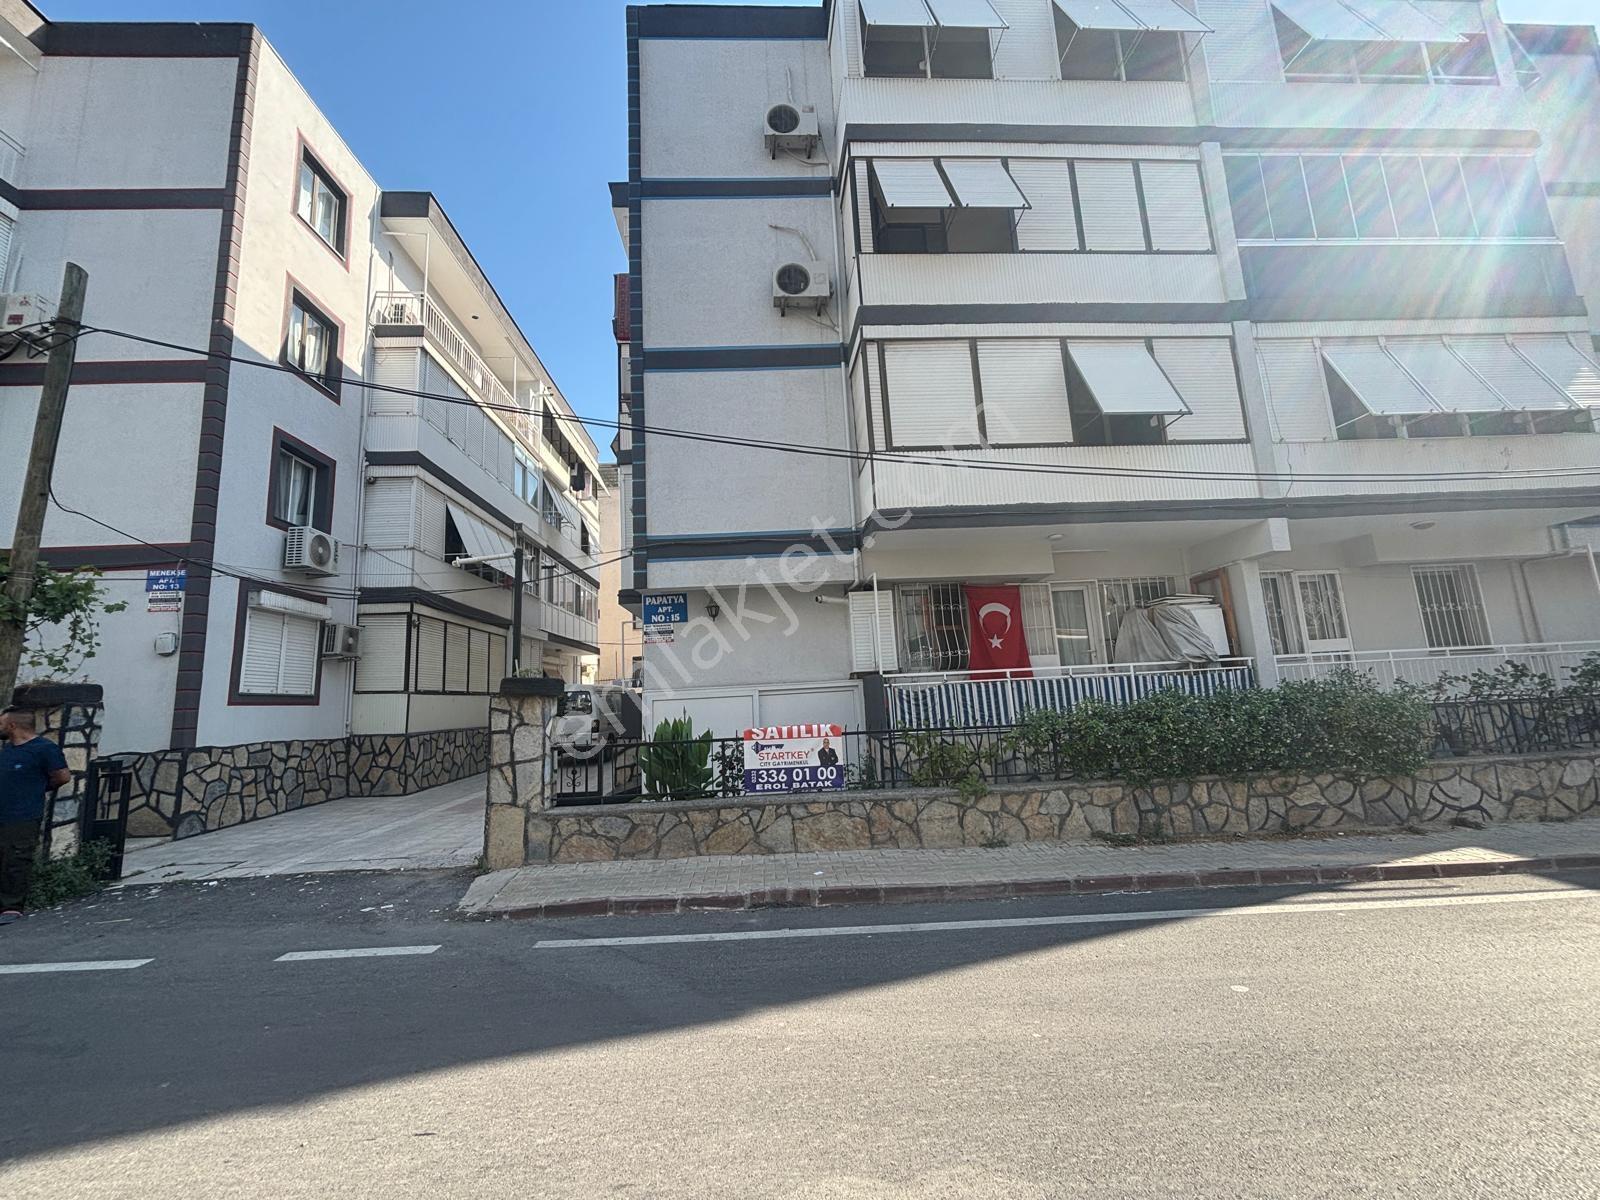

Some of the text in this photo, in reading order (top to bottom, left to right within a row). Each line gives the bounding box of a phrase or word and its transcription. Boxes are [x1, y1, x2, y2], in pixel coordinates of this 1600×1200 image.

[645, 596, 684, 605] PAPATYA
[752, 724, 833, 739] SATILIK
[758, 751, 809, 760] STARTKEY
[758, 766, 837, 783] 336 01 00
